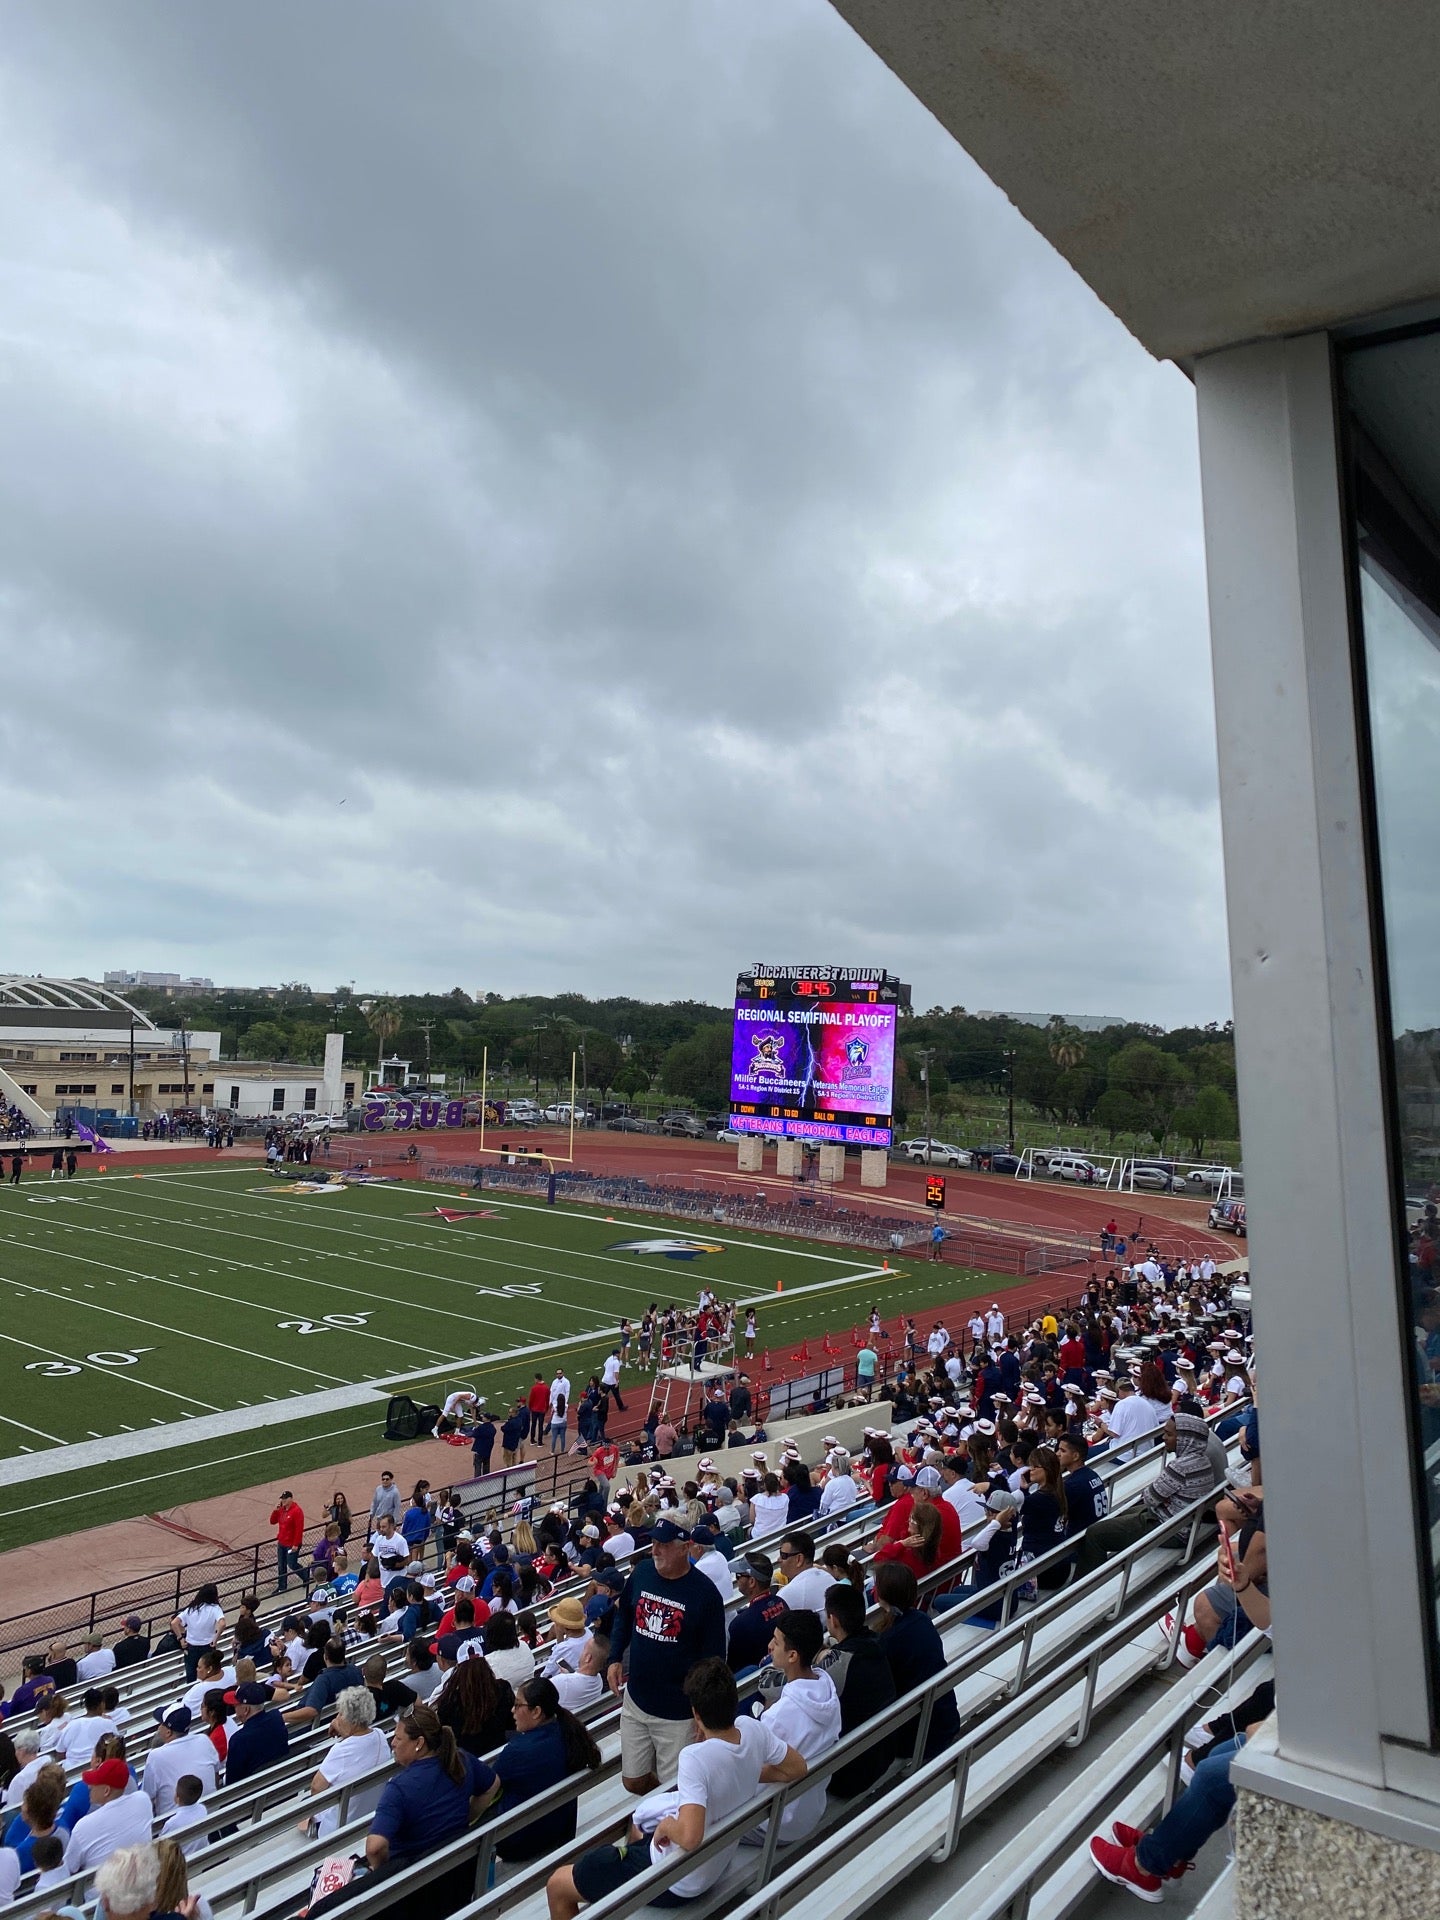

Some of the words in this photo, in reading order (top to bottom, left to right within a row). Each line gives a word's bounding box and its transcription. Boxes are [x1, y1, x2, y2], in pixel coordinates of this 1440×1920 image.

[751, 963, 819, 979] BUCCANEER
[820, 965, 883, 981] STADIUM
[760, 986, 768, 998] 0
[868, 991, 877, 1002] 0
[737, 1008, 785, 1022] REGIONAL
[787, 1011, 842, 1025] SEMIFINAL
[845, 1014, 891, 1028] PLAYOFF
[734, 1074, 757, 1083] Miller
[759, 1076, 806, 1087] Buccaneers
[812, 1080, 838, 1090] Veterans
[839, 1082, 867, 1092] Memorial
[868, 1084, 889, 1095] Eagles
[774, 1086, 792, 1094] District
[831, 1091, 849, 1099] Region
[740, 1105, 755, 1114] DOWN
[771, 1106, 779, 1117] 10
[784, 1109, 791, 1117] TO
[791, 1110, 799, 1118] GO
[813, 1112, 826, 1120] BALL
[827, 1113, 835, 1121] ON
[731, 1117, 784, 1133] VETERANS
[786, 1122, 843, 1139] MEMORIAL
[846, 1128, 889, 1143] EAGLES
[928, 1187, 942, 1201] 25
[476, 1284, 543, 1299] 10
[276, 1314, 368, 1335] 20
[24, 1351, 140, 1376] 30
[640, 1590, 663, 1604] VETERANS
[662, 1597, 686, 1611] MEMORIAL
[635, 1625, 678, 1643] BASKETBALL
